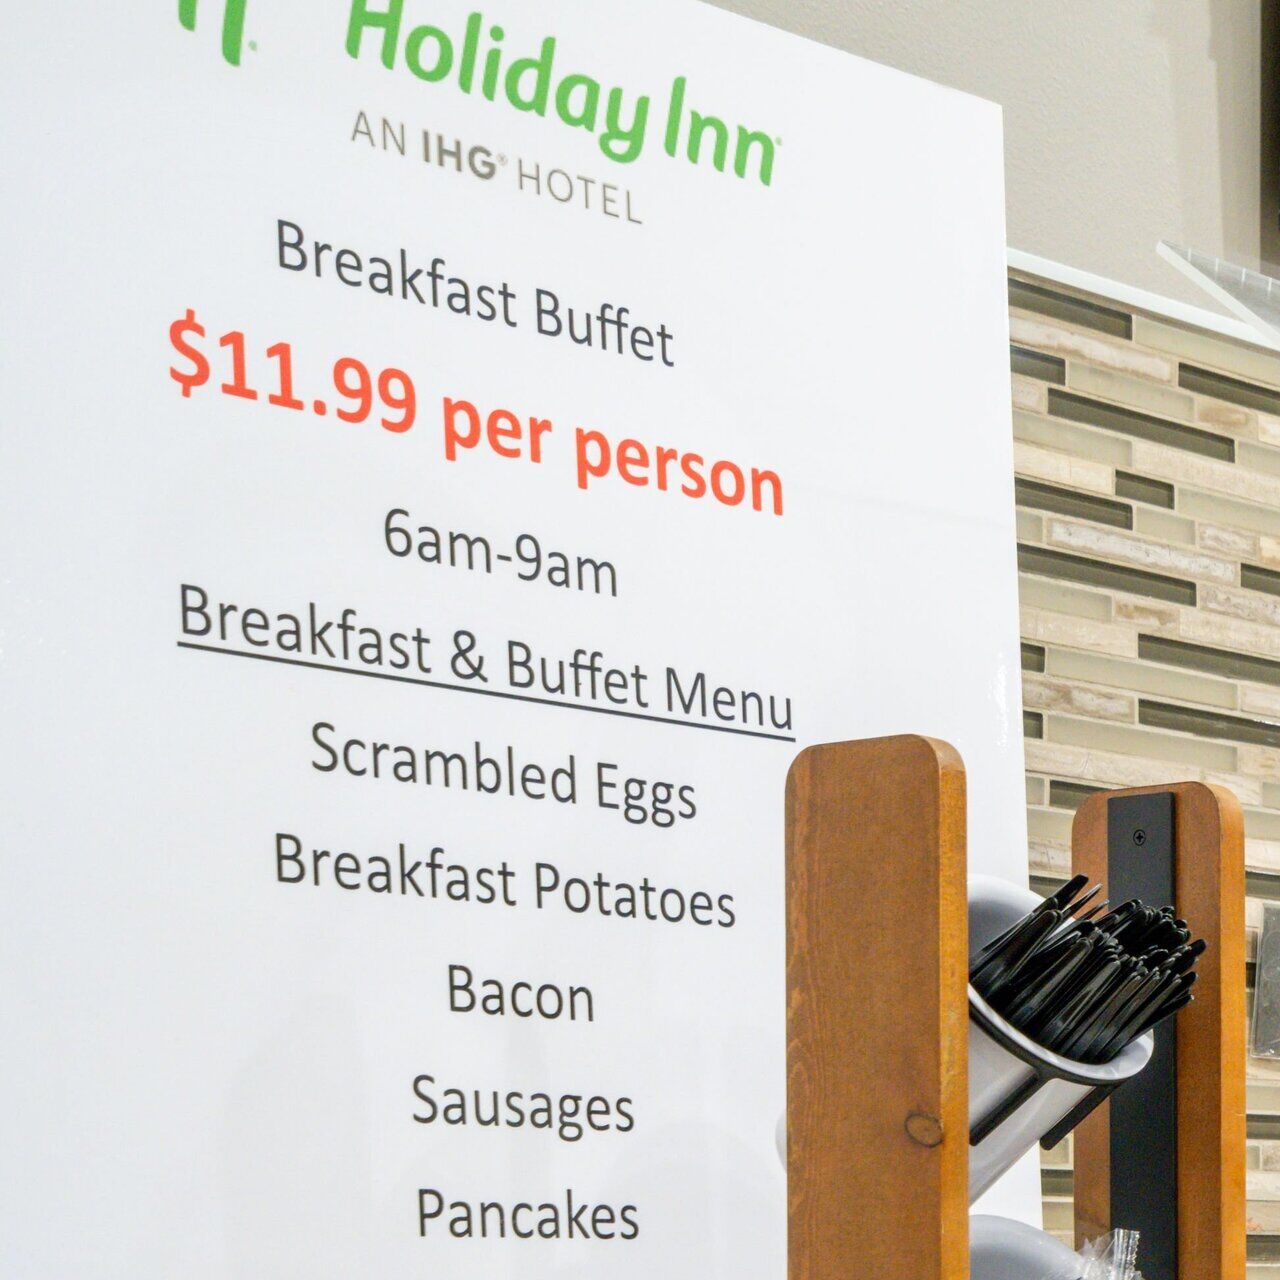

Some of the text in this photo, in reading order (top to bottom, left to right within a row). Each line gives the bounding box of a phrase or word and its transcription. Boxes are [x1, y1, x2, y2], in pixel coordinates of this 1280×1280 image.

[345, 0, 650, 166] Holiday
[664, 76, 780, 187] Inn
[350, 110, 407, 158] AN
[518, 157, 644, 225] HOTEL
[277, 219, 675, 368] Breakfast Buffet
[168, 308, 784, 517] $11.99 per person
[384, 508, 619, 597] 6am-9am
[181, 584, 794, 731] Breakfast & Buffet Menu
[311, 721, 697, 828] Scrambled Eggs
[275, 832, 736, 928] Breakfast Potatoes
[448, 963, 595, 1022] Bacon
[412, 1073, 635, 1142] Sausages
[418, 1188, 640, 1240] Pancakes
